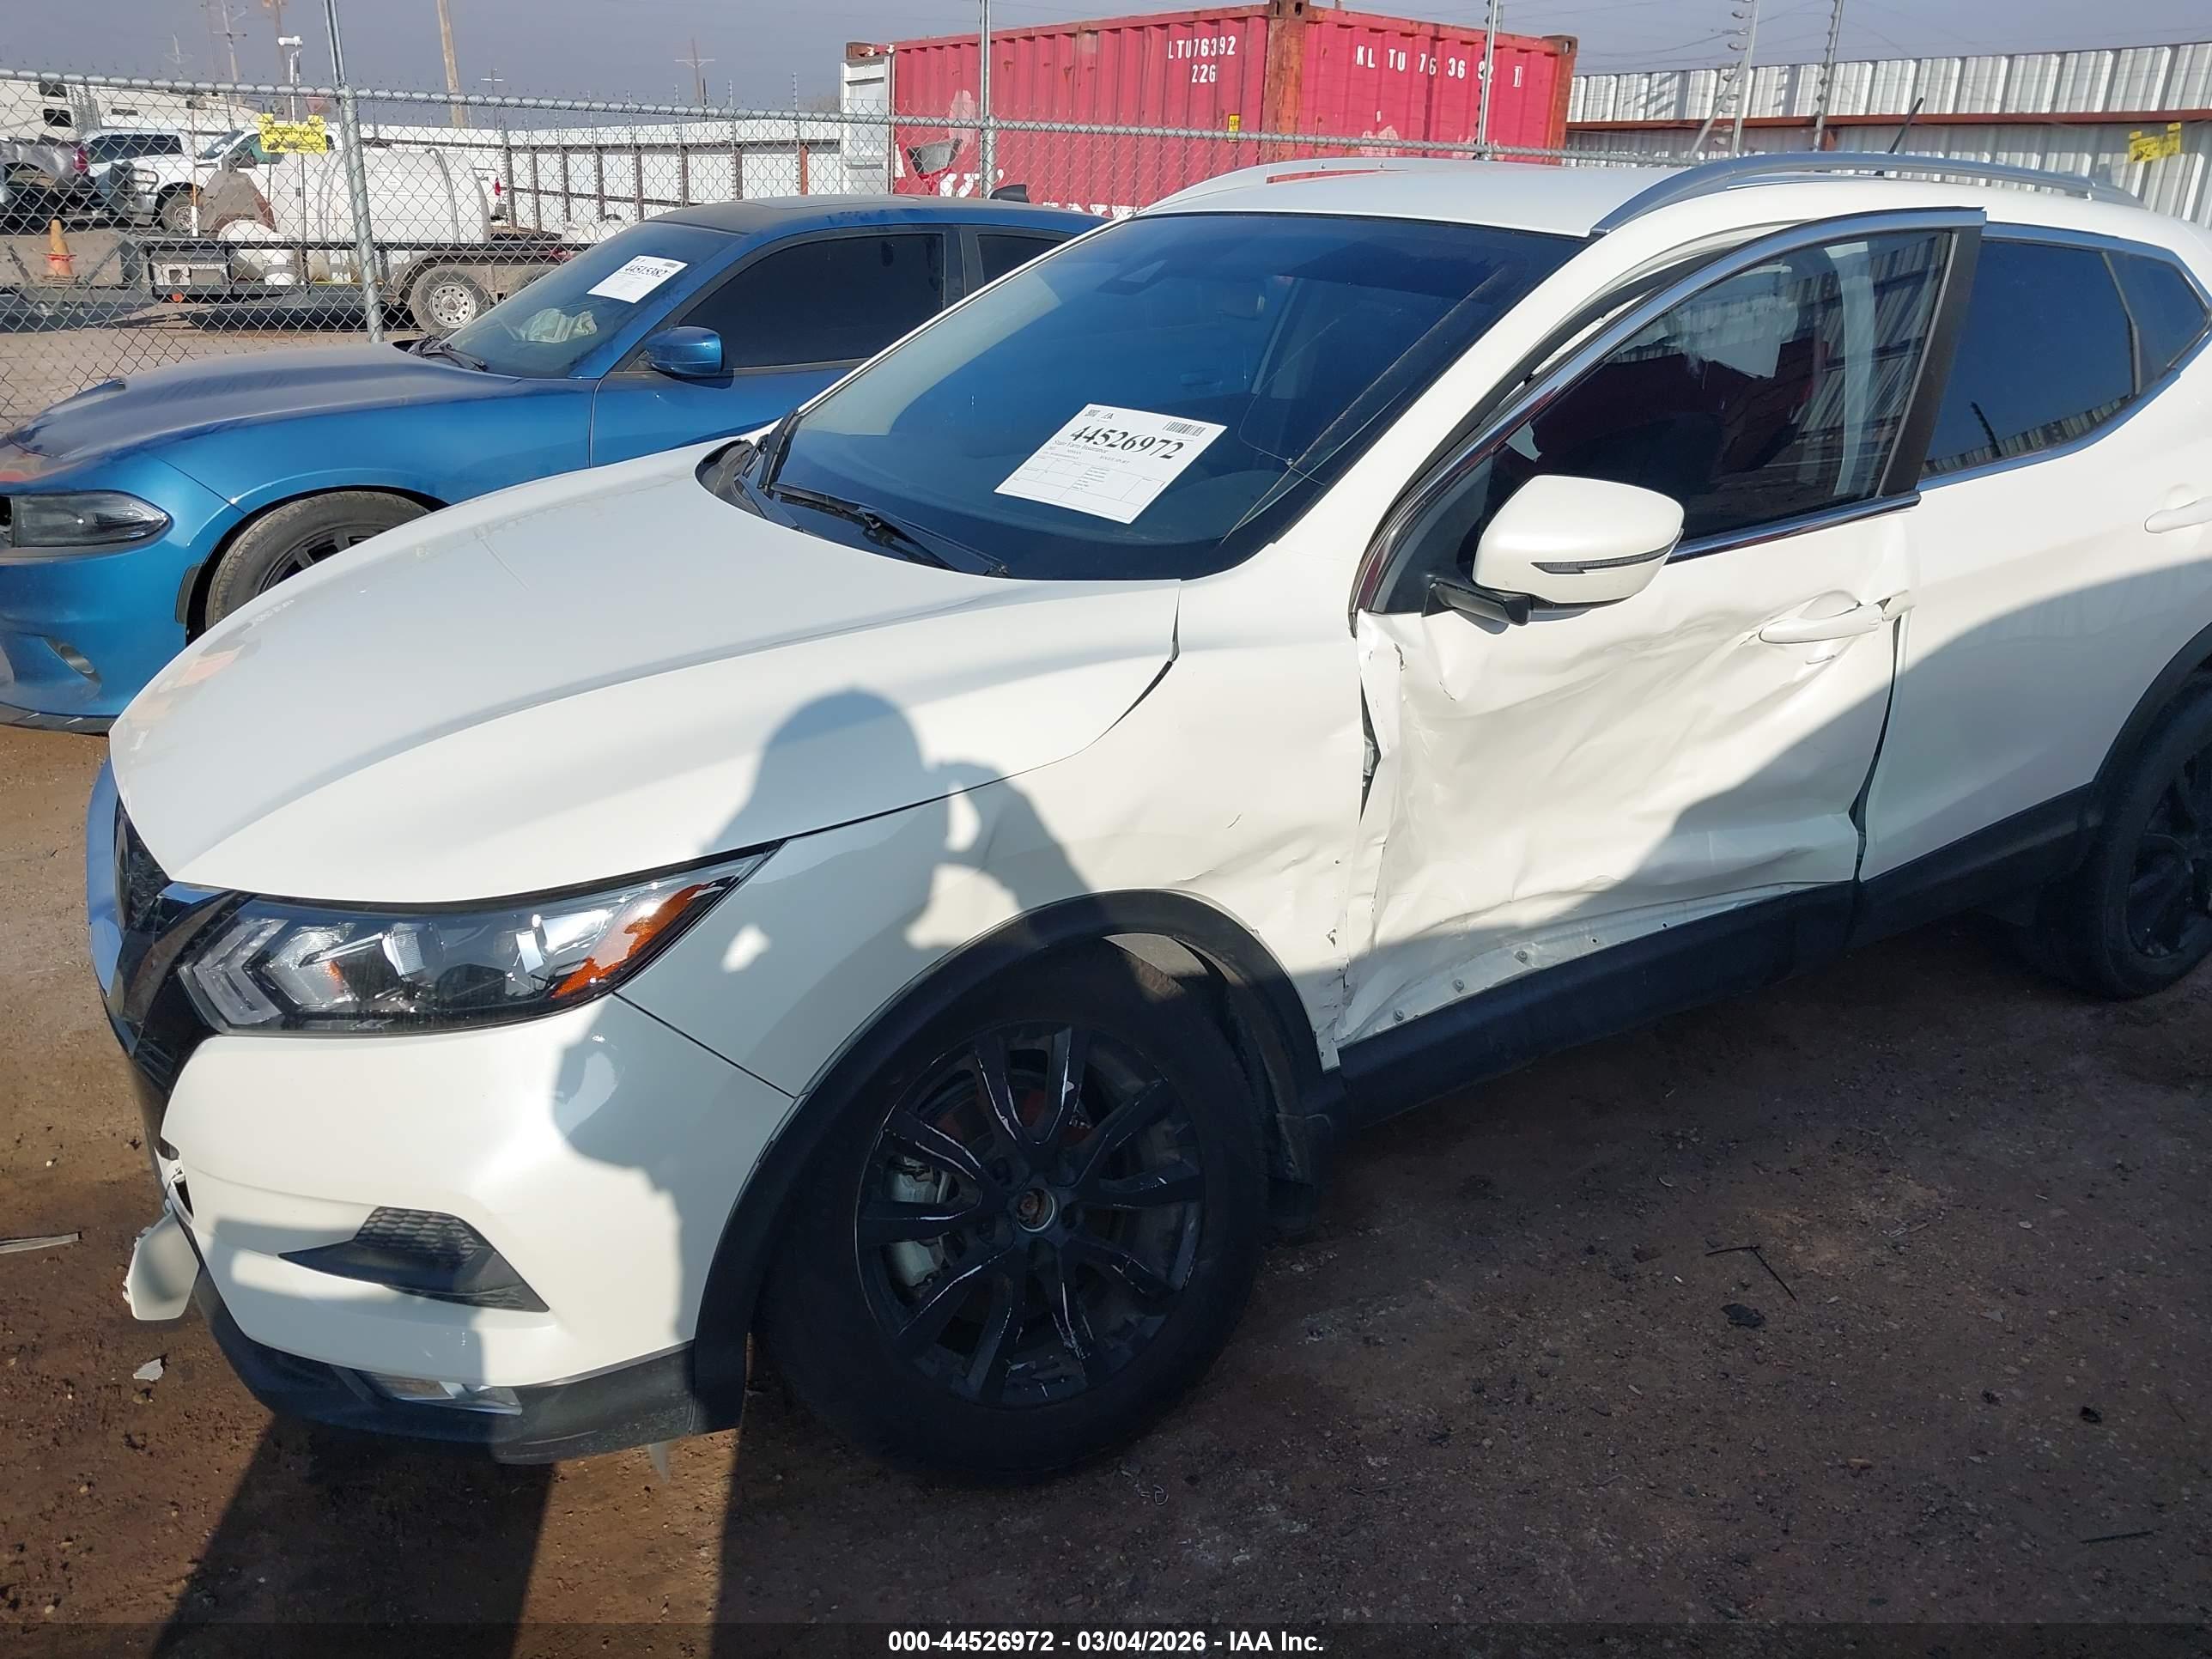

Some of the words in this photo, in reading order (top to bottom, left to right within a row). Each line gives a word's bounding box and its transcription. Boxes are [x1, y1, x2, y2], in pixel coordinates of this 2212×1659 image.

[1168, 35, 1237, 59] LTU76392
[1419, 53, 1437, 76] 76
[1448, 57, 1466, 79] 36
[1070, 425, 1184, 459] 44526972
